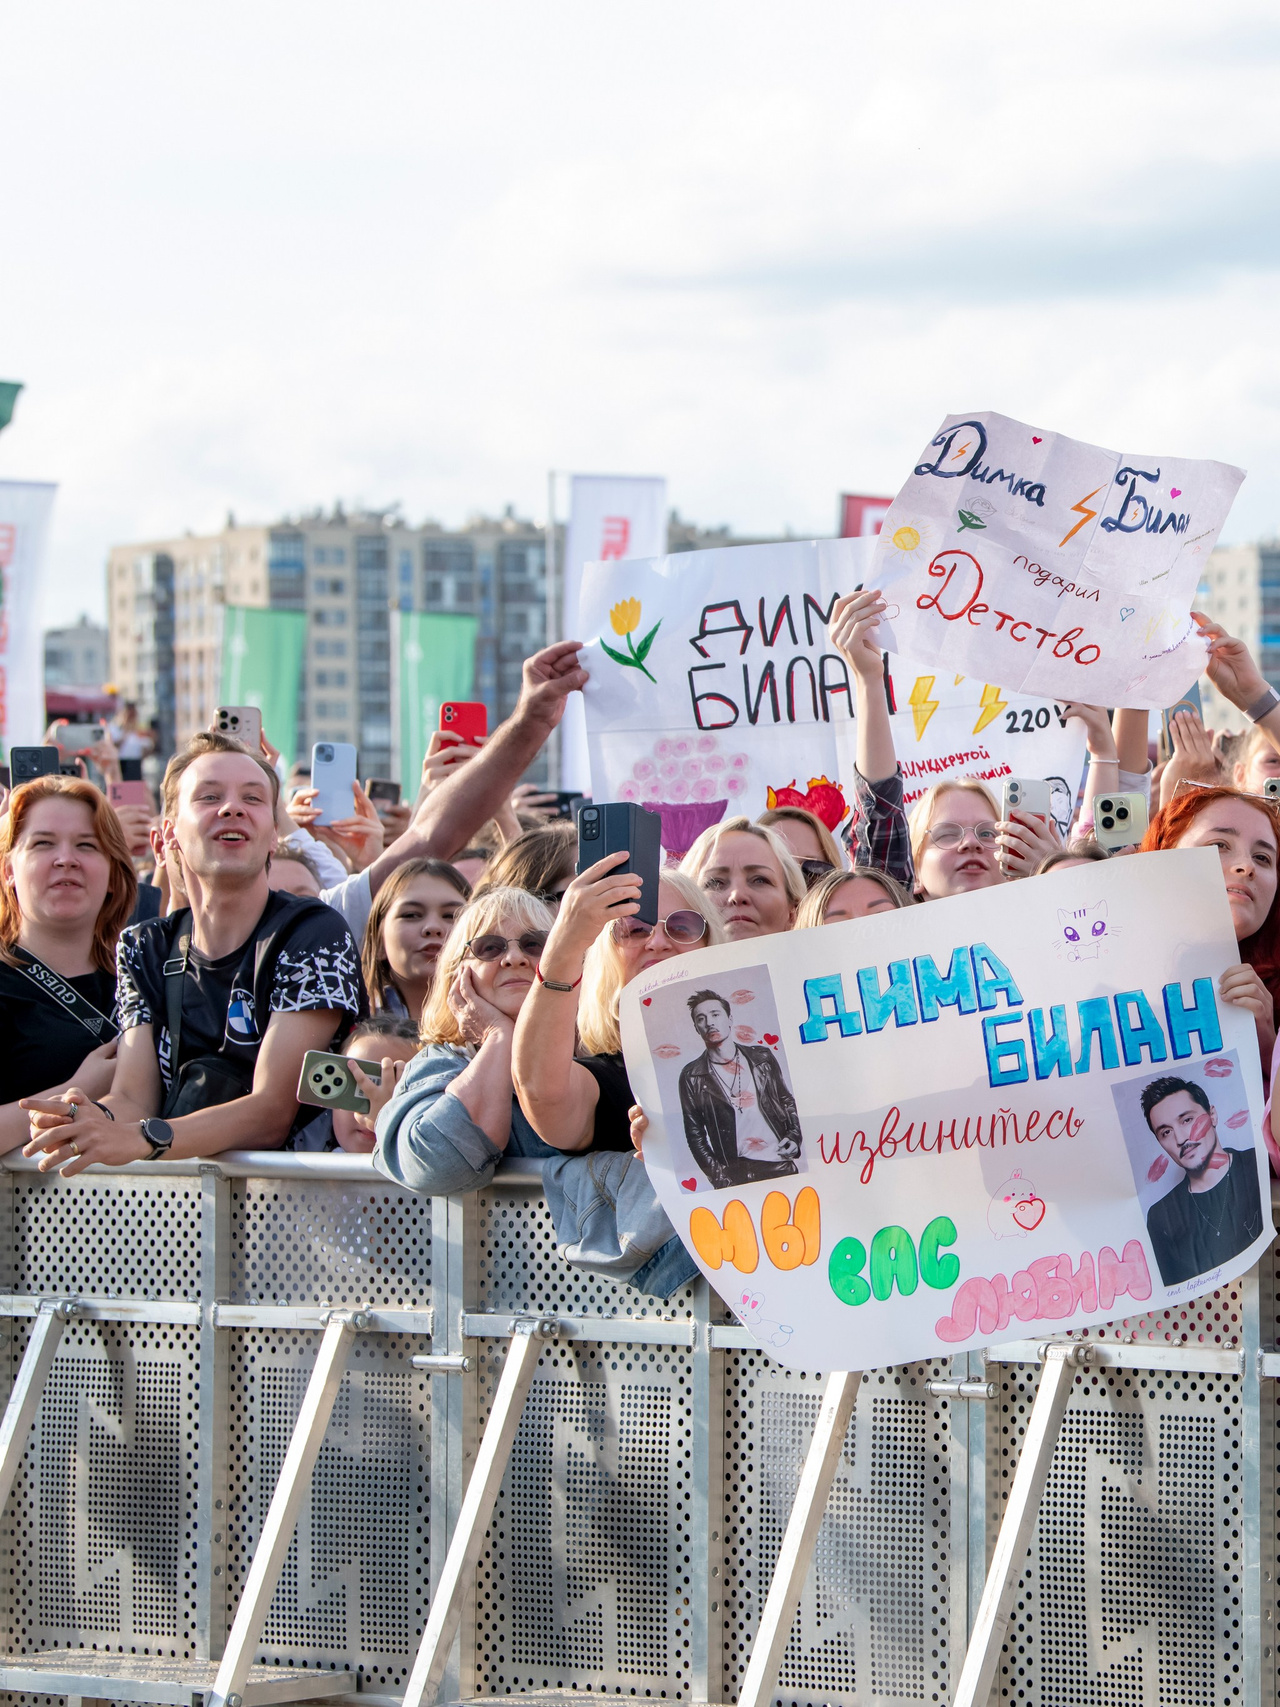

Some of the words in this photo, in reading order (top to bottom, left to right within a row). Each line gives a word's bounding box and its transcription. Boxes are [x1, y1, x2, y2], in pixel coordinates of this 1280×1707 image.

[914, 420, 1047, 507] Димка
[916, 549, 1101, 665] Детство
[1013, 554, 1101, 602] подарил
[689, 583, 864, 658] ДИМ
[1006, 707, 1051, 733] 220
[26, 963, 78, 1005] GUESS
[798, 942, 1024, 1045] ДИМА
[981, 976, 1224, 1088] БИЛАН
[817, 1106, 1086, 1185] извинитесь
[689, 1186, 822, 1275] МЫ
[935, 1239, 1153, 1343] ЛЮБИМ
